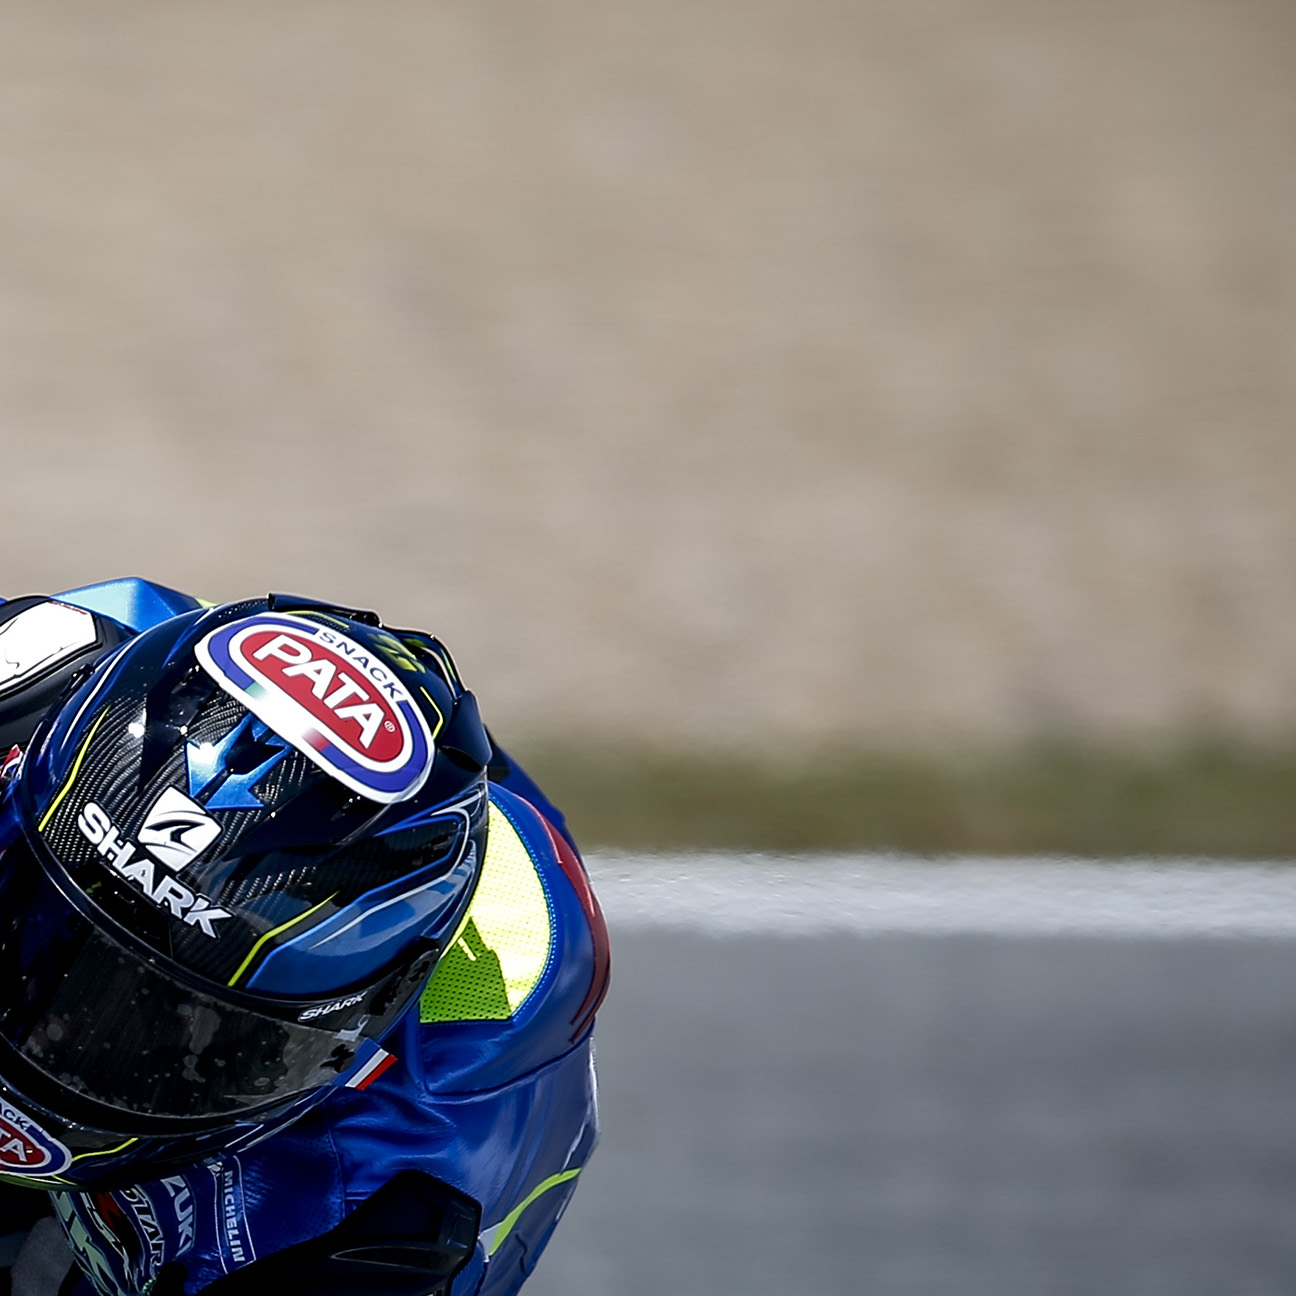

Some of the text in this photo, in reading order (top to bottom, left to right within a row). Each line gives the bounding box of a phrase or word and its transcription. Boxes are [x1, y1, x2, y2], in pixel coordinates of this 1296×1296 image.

[252, 634, 385, 749] PATA
[319, 631, 403, 700] SNACK
[77, 802, 233, 939] SHARK
[298, 991, 368, 1022] SHARK
[160, 1174, 194, 1258] ZUKI
[223, 1170, 246, 1262] MICHELIN
